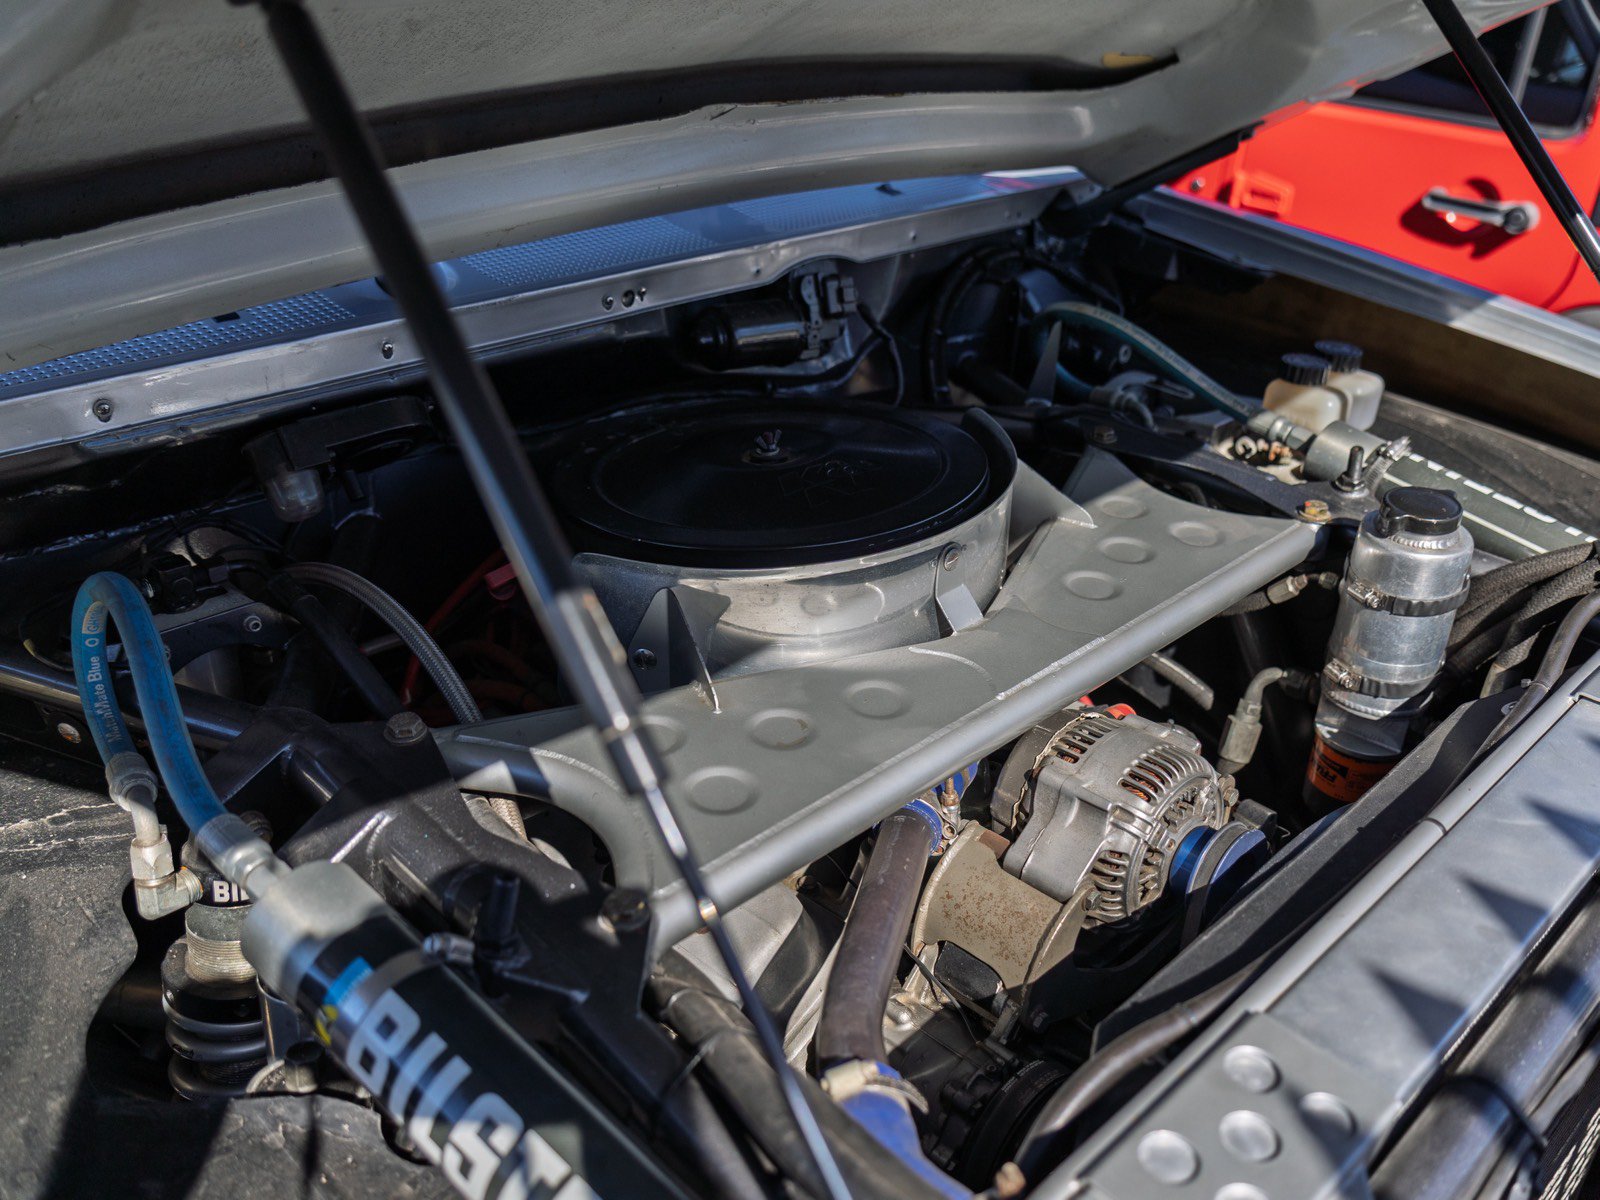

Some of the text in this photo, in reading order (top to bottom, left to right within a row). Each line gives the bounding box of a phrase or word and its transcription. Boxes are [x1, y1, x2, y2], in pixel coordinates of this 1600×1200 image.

[88, 656, 102, 682] Blue
[94, 683, 122, 743] MatchMate
[345, 989, 604, 1200] BILST
